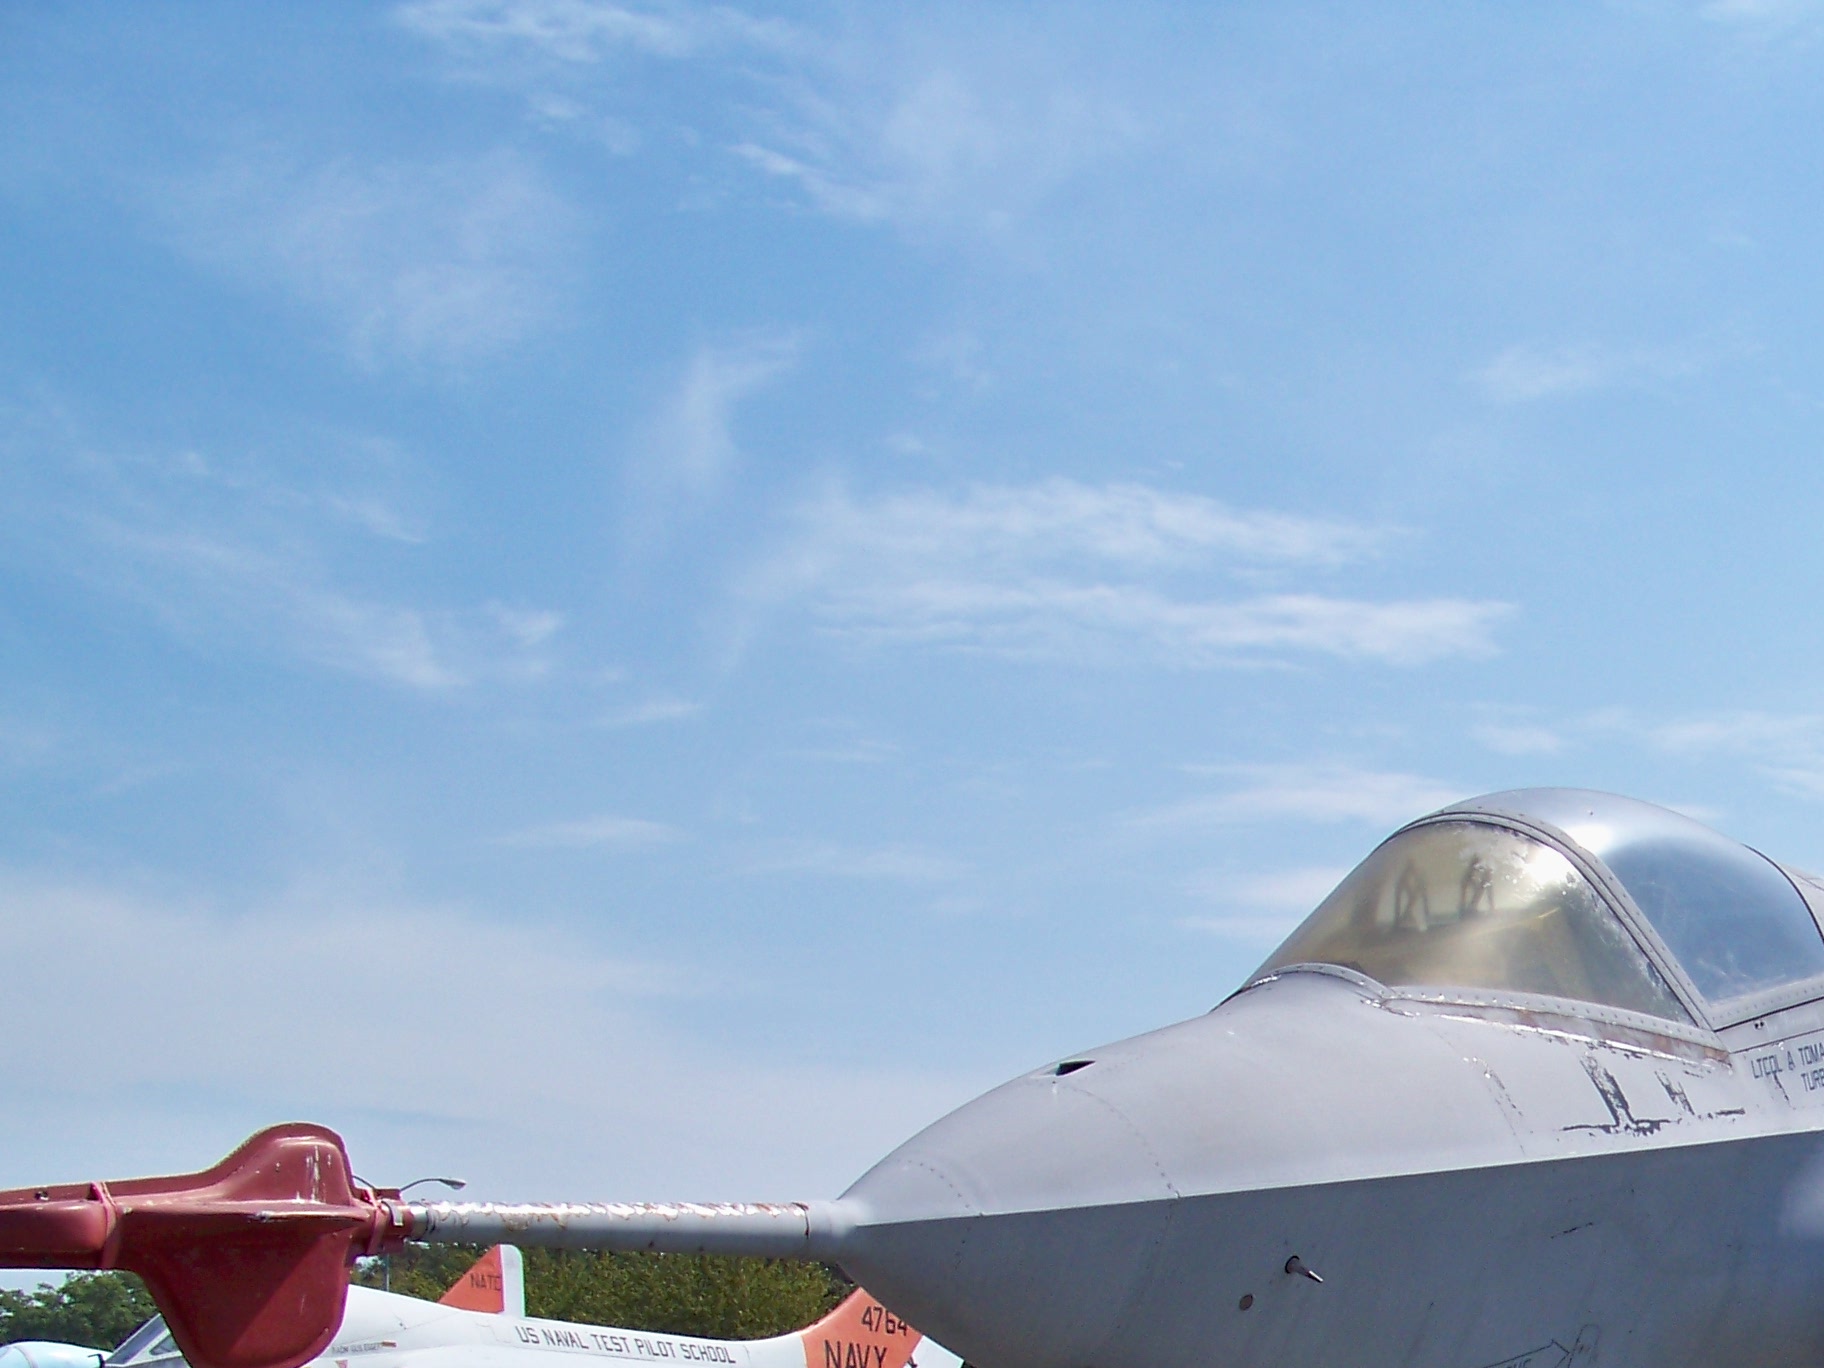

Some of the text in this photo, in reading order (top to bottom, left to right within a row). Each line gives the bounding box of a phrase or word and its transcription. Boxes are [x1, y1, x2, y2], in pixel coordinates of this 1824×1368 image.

[1787, 1050, 1796, 1071] A
[862, 1306, 907, 1337] 4764
[515, 1326, 736, 1364] US NAVAL TEST PILOT SCHOOL
